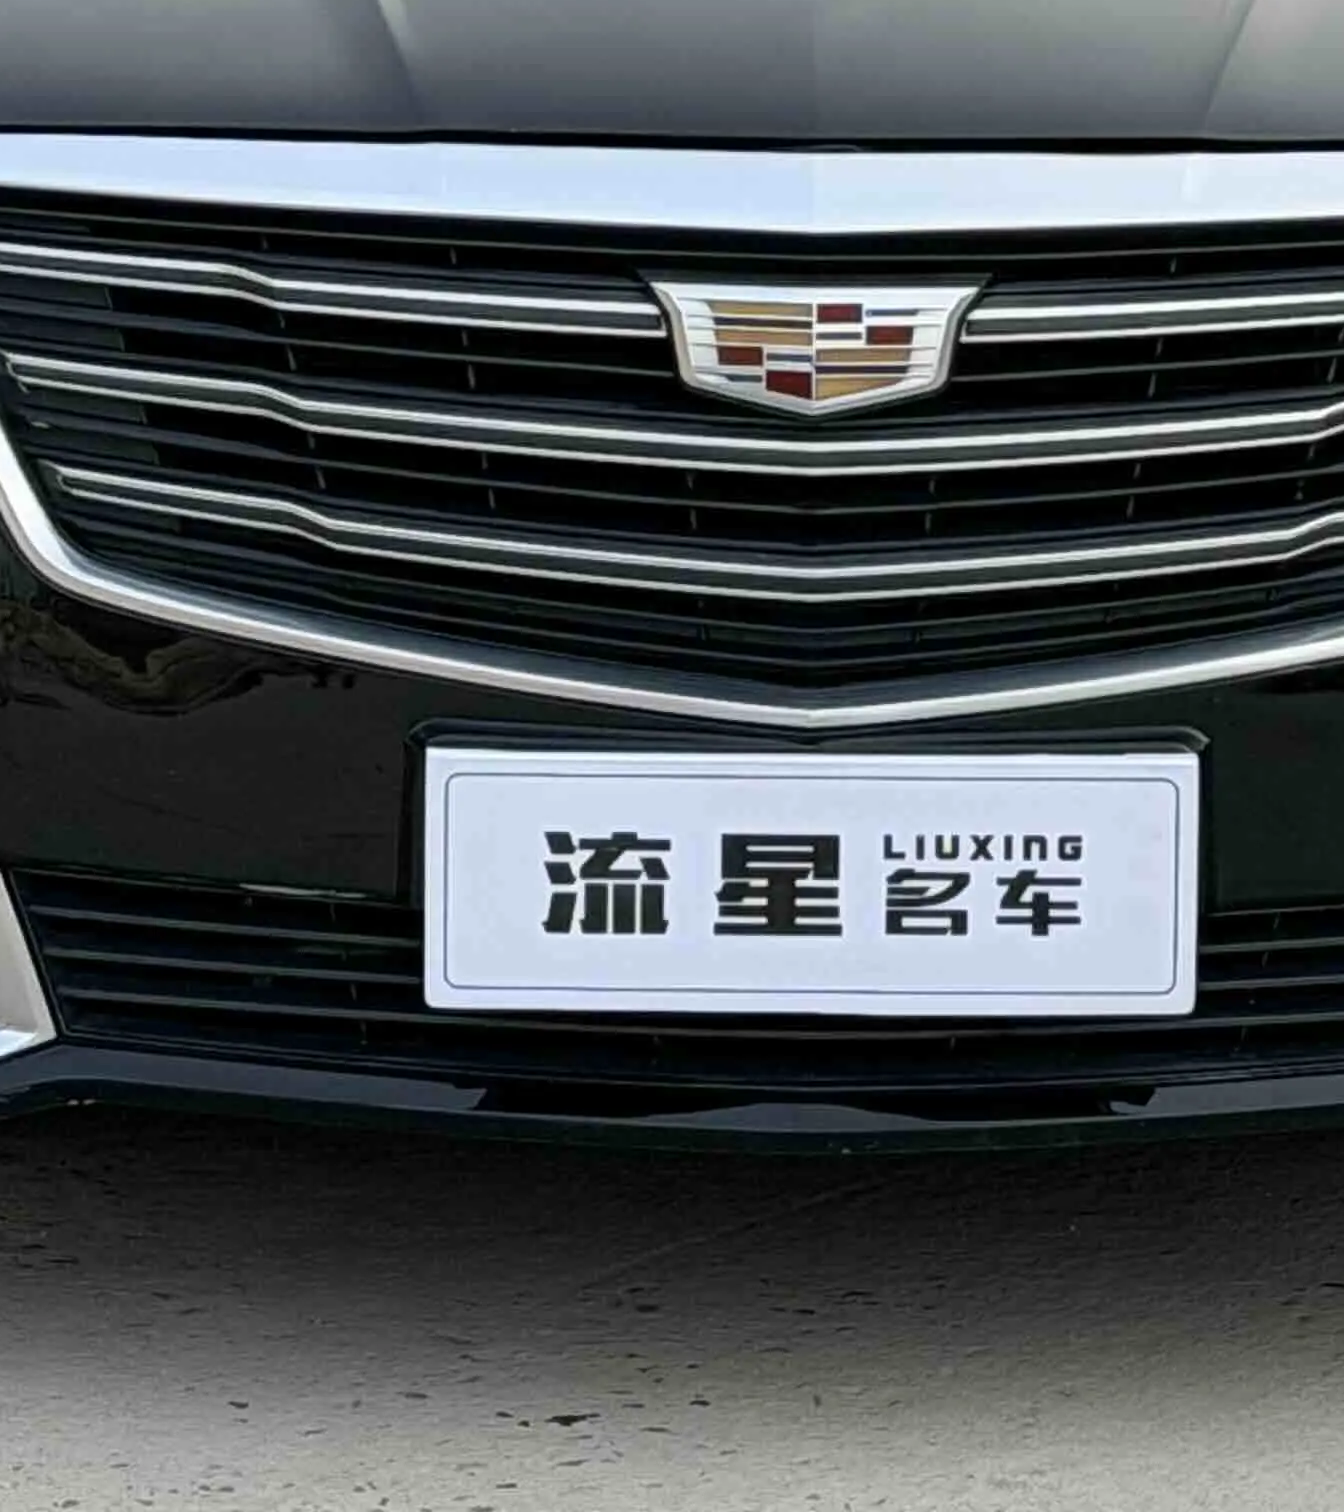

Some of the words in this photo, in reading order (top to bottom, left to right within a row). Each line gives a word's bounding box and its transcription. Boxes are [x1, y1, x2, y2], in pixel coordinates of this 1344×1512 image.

[885, 835, 1082, 860] LIUXING
[543, 832, 842, 936] 流星
[886, 868, 1082, 936] 名车
